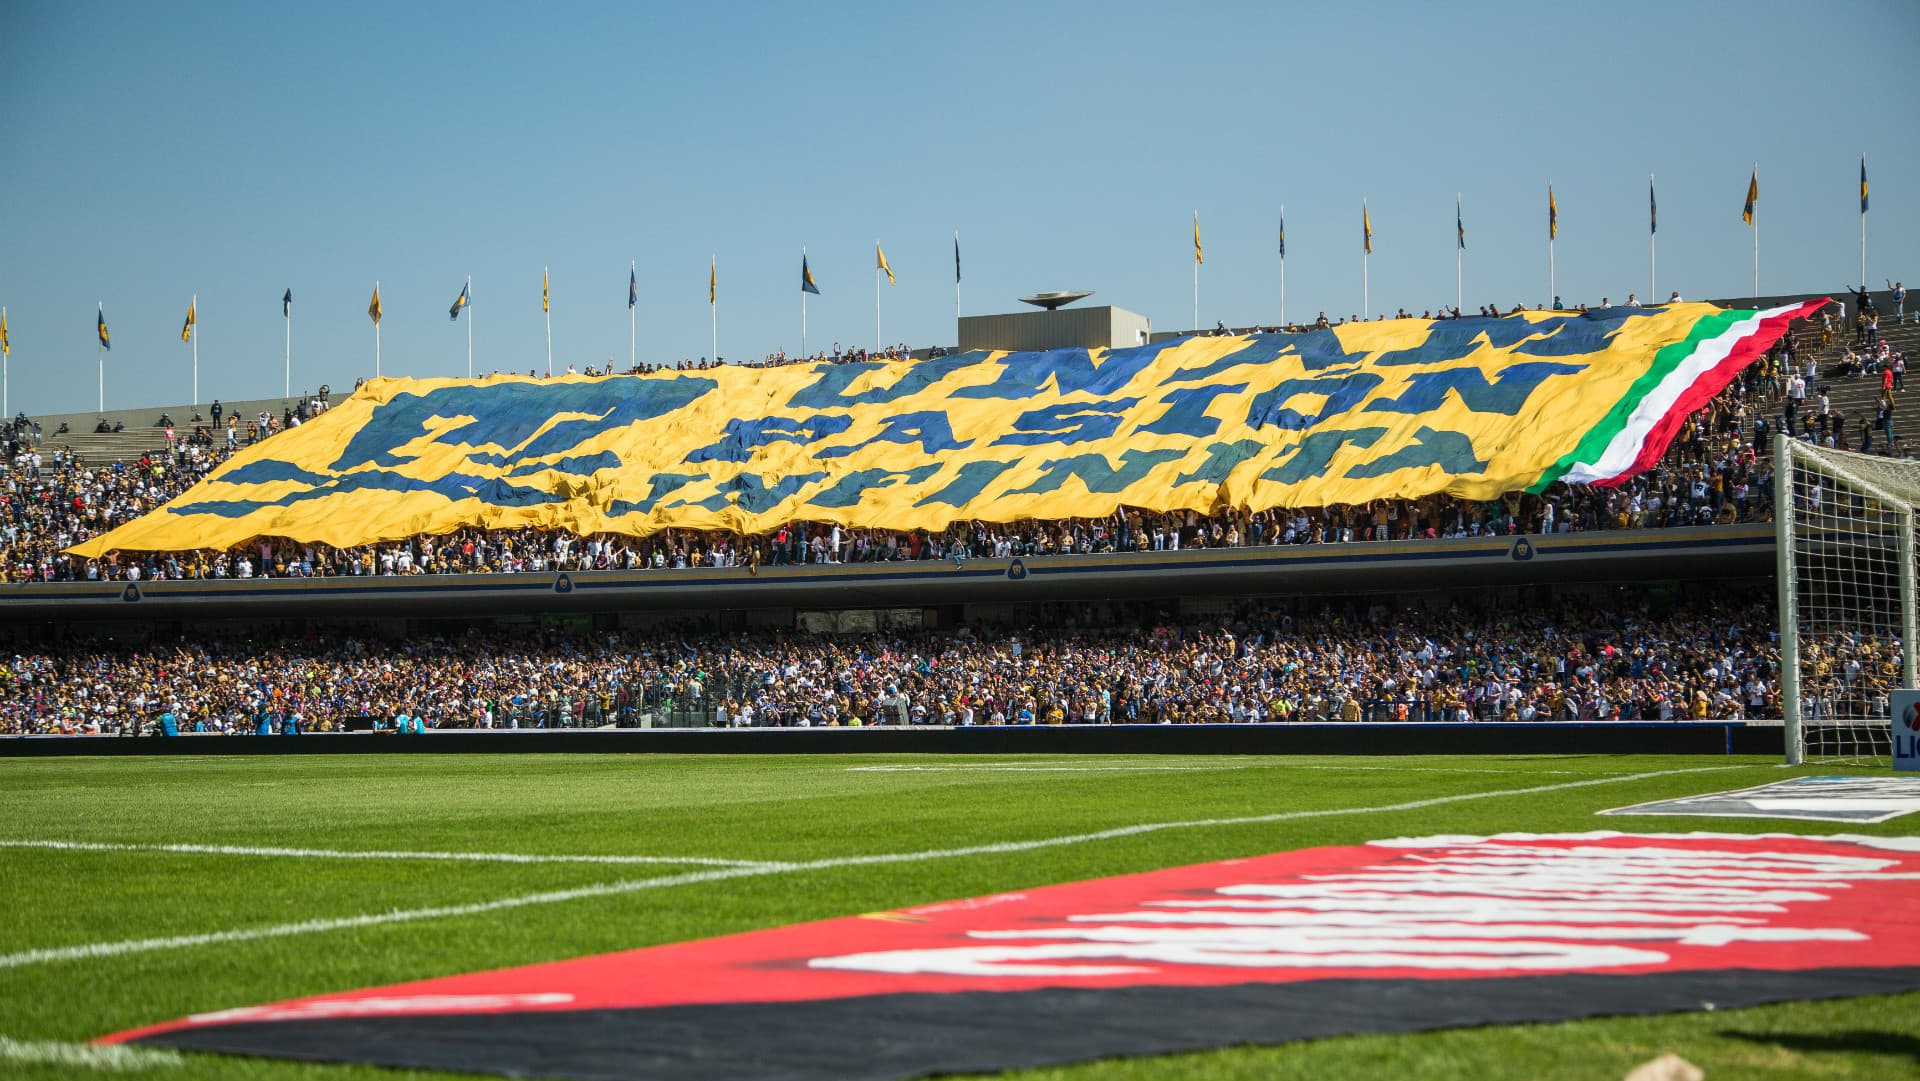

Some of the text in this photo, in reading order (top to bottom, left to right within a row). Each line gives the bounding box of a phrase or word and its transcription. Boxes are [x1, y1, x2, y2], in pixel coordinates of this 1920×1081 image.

[786, 306, 1672, 408] UNAM
[604, 425, 1489, 518] INFINITA
[1896, 735, 1920, 759] LI
